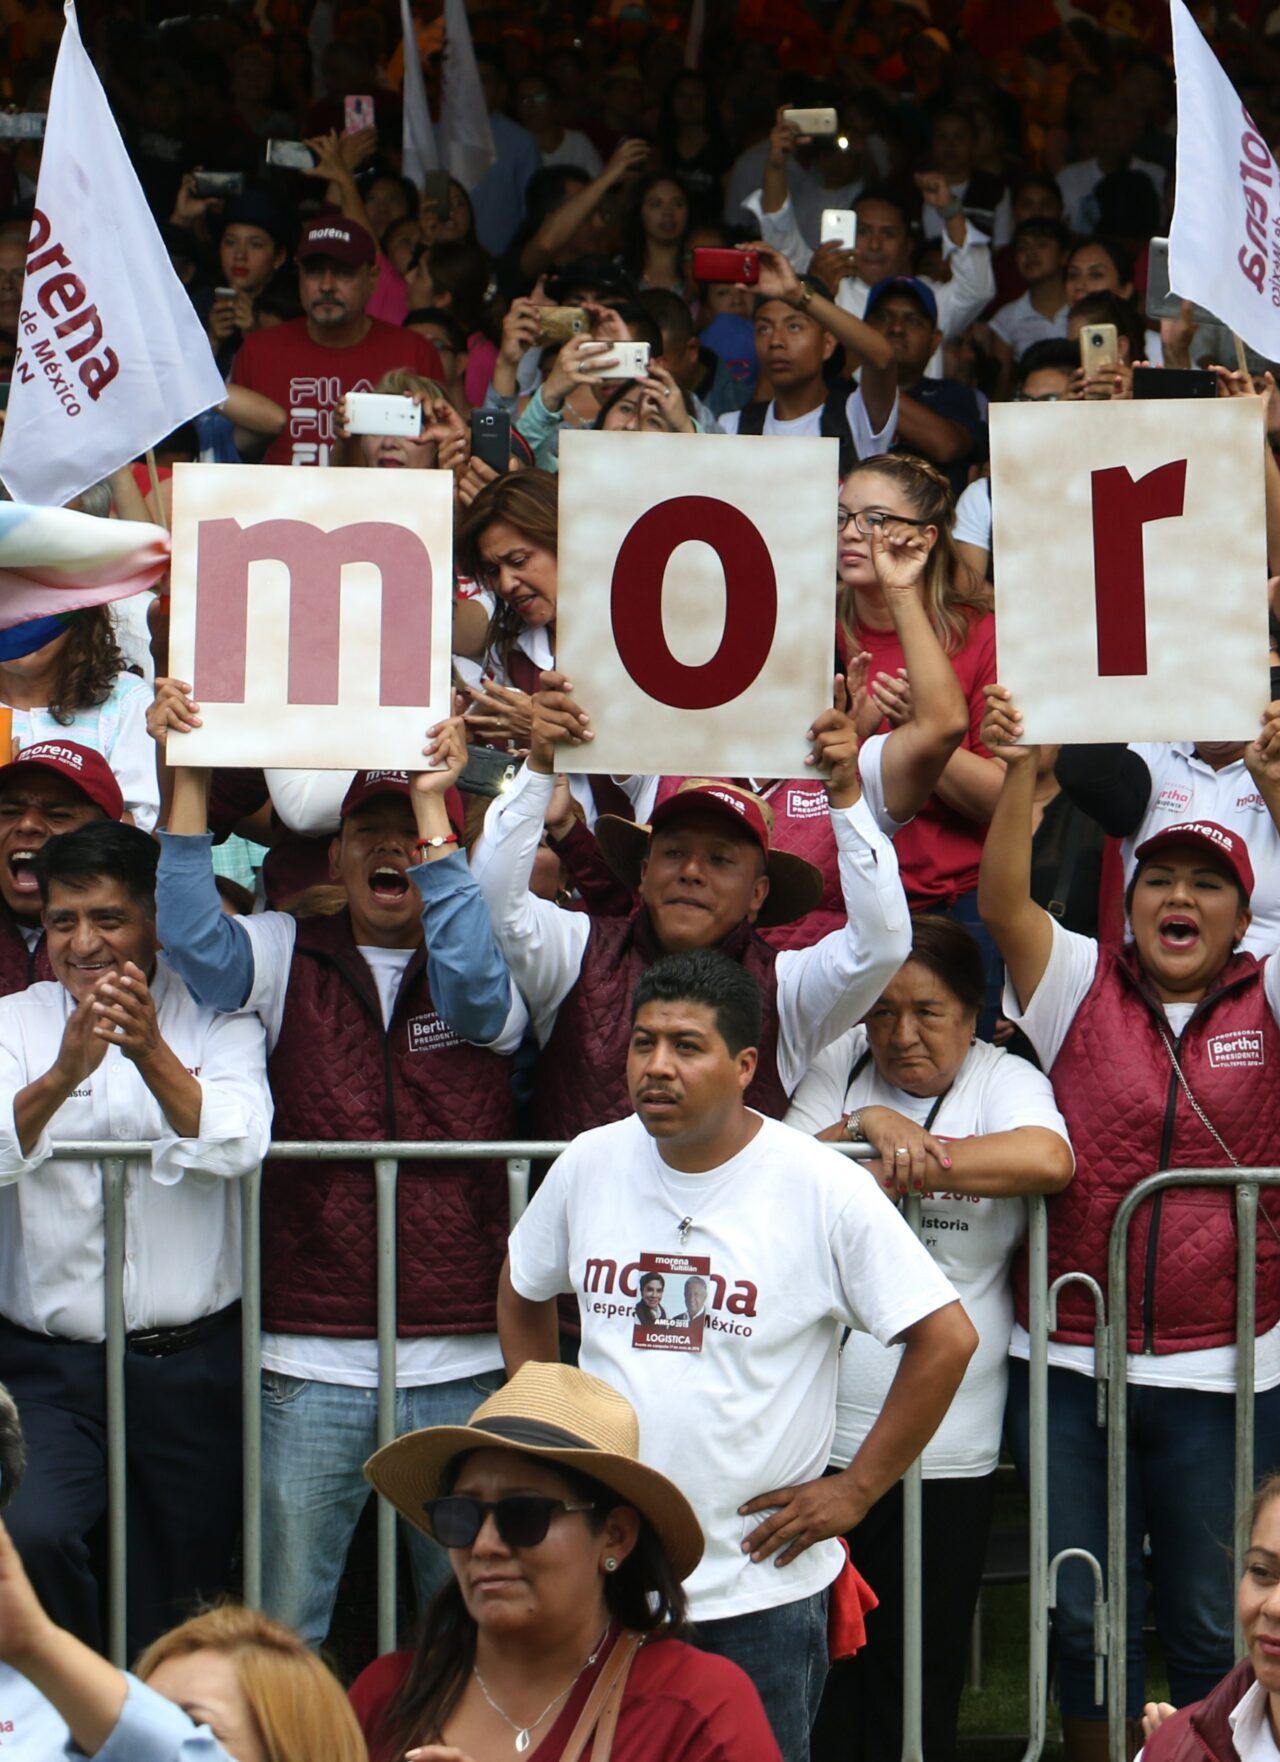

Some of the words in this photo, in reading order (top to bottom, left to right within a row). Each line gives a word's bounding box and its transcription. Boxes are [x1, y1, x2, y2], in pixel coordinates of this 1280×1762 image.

[308, 228, 351, 242] morena
[25, 208, 120, 402] orena
[19, 309, 38, 336] de
[30, 338, 82, 417] México
[1091, 458, 1188, 677] r
[611, 495, 777, 709] o
[194, 517, 433, 707] m
[19, 744, 83, 767] morena
[366, 769, 409, 781] more
[707, 791, 746, 812] ena
[793, 794, 829, 807] Berth
[1159, 789, 1189, 803] rtha
[1236, 793, 1266, 808] more
[413, 1020, 450, 1036] Bert
[1213, 1036, 1259, 1054] Bertha
[1215, 1051, 1259, 1062] PRESIDENTA
[921, 1217, 969, 1232] istoria
[655, 1257, 689, 1266] morena
[583, 1259, 758, 1318] mona
[593, 1302, 637, 1319] esper
[646, 1333, 691, 1345] LOGISTICA
